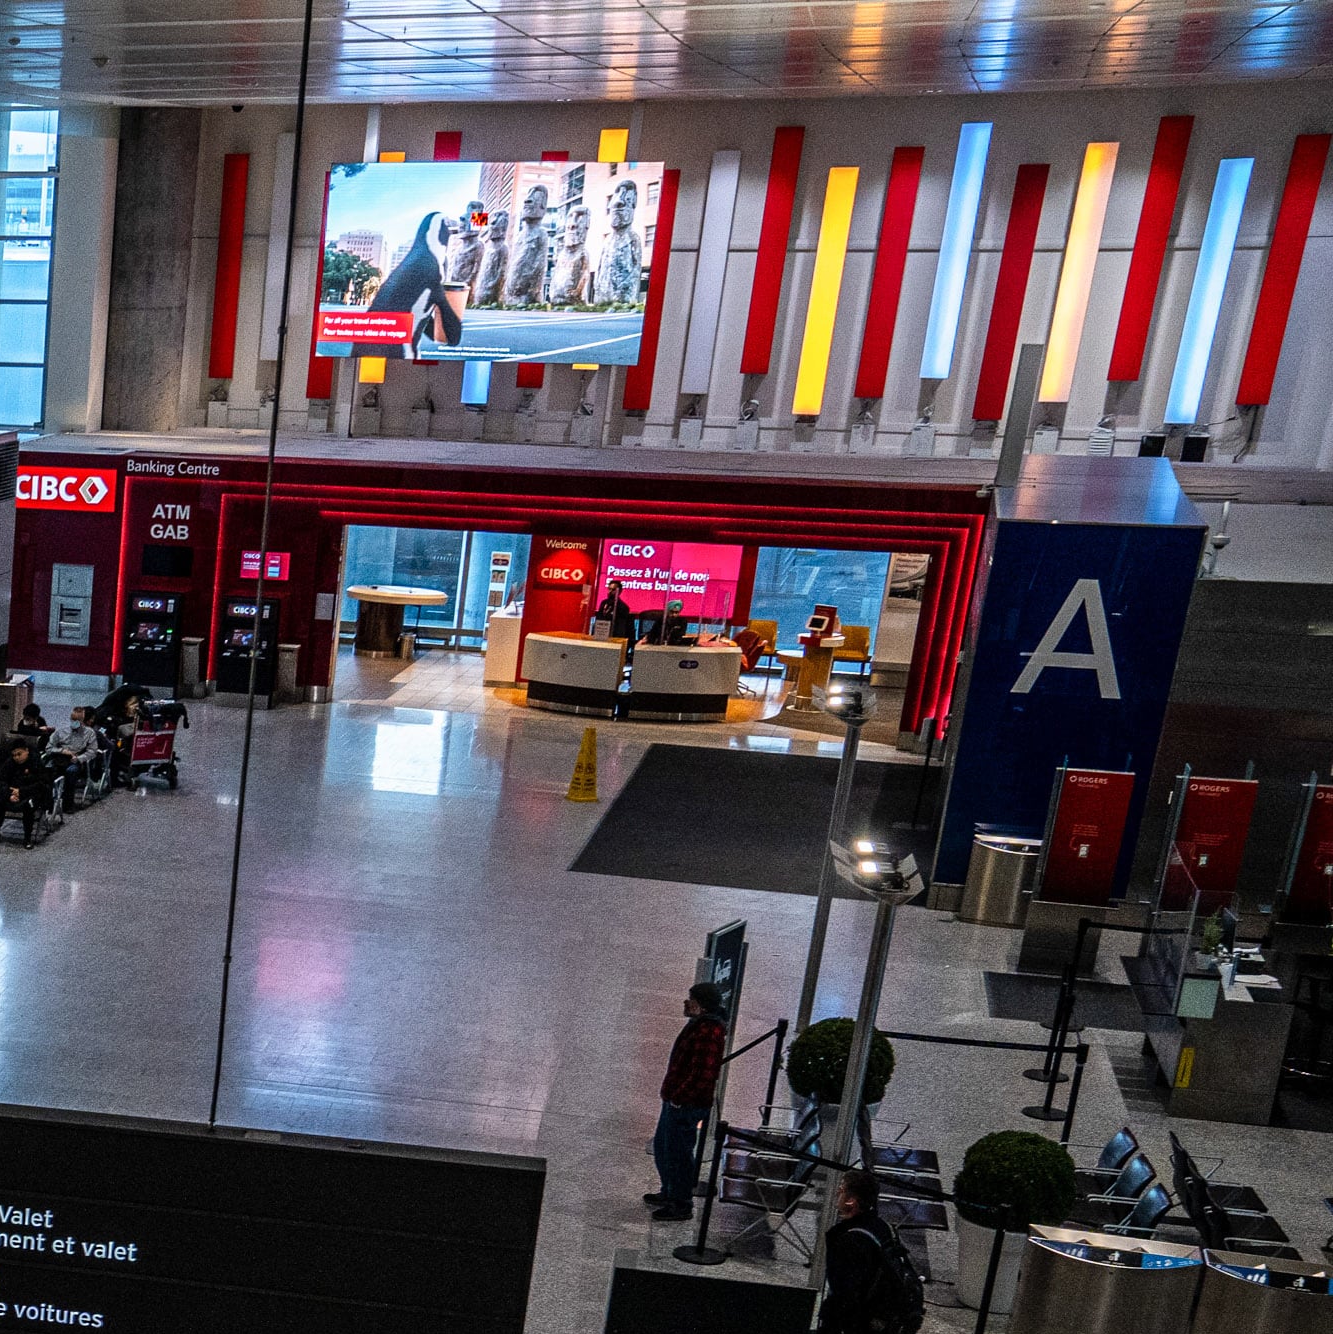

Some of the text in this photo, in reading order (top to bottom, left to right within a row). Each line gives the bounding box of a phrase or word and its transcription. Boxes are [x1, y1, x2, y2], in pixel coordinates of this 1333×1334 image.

[126, 460, 220, 477] Banking Centre
[16, 474, 78, 502] CIBC
[151, 503, 191, 520] ATM
[149, 523, 189, 540] GAB
[545, 539, 588, 550] Welcome
[609, 544, 641, 558] CIBC
[540, 567, 570, 580] CIBC
[606, 566, 643, 578] Passez
[644, 567, 651, 578] à
[674, 570, 689, 581] de
[654, 581, 705, 594] bancaires
[1011, 579, 1121, 699] A
[1078, 775, 1108, 786] ROGERS
[1199, 784, 1231, 793] ROGERS
[53, 1235, 76, 1254] et
[82, 1241, 138, 1262] valet
[14, 1303, 104, 1328] voitures
